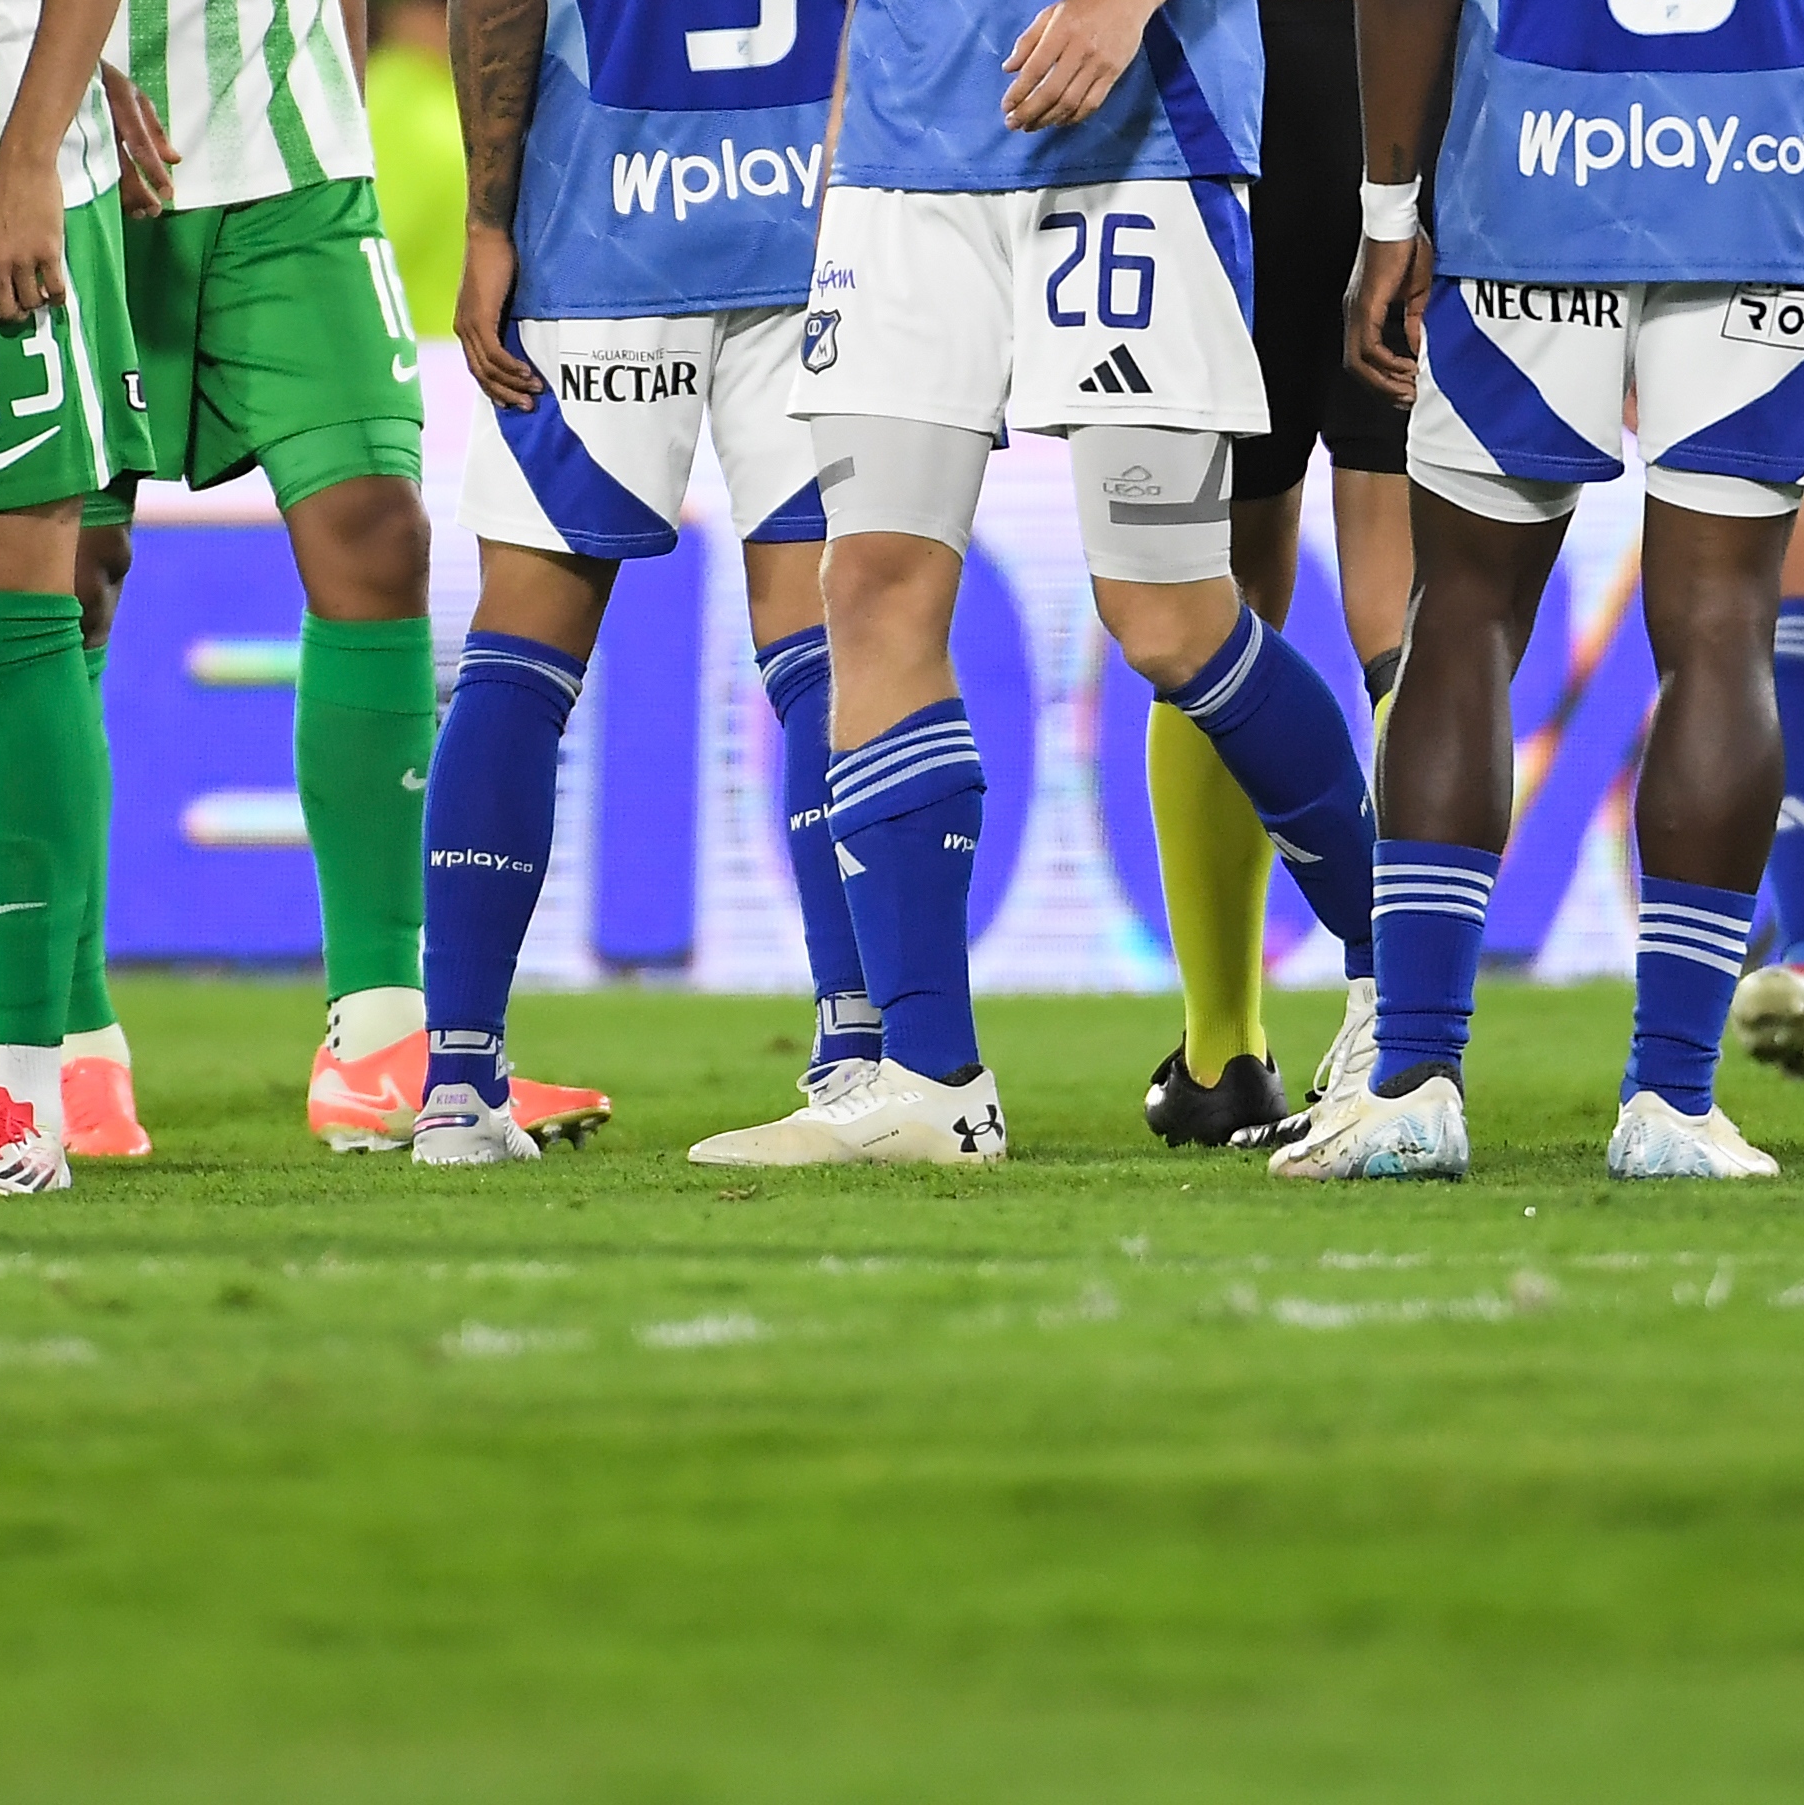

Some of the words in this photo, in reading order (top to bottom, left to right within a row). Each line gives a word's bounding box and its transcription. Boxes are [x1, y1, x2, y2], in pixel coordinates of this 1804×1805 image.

[1039, 212, 1156, 329] 26
[1474, 282, 1623, 329] NECTAR
[561, 359, 697, 404] NECTAR
